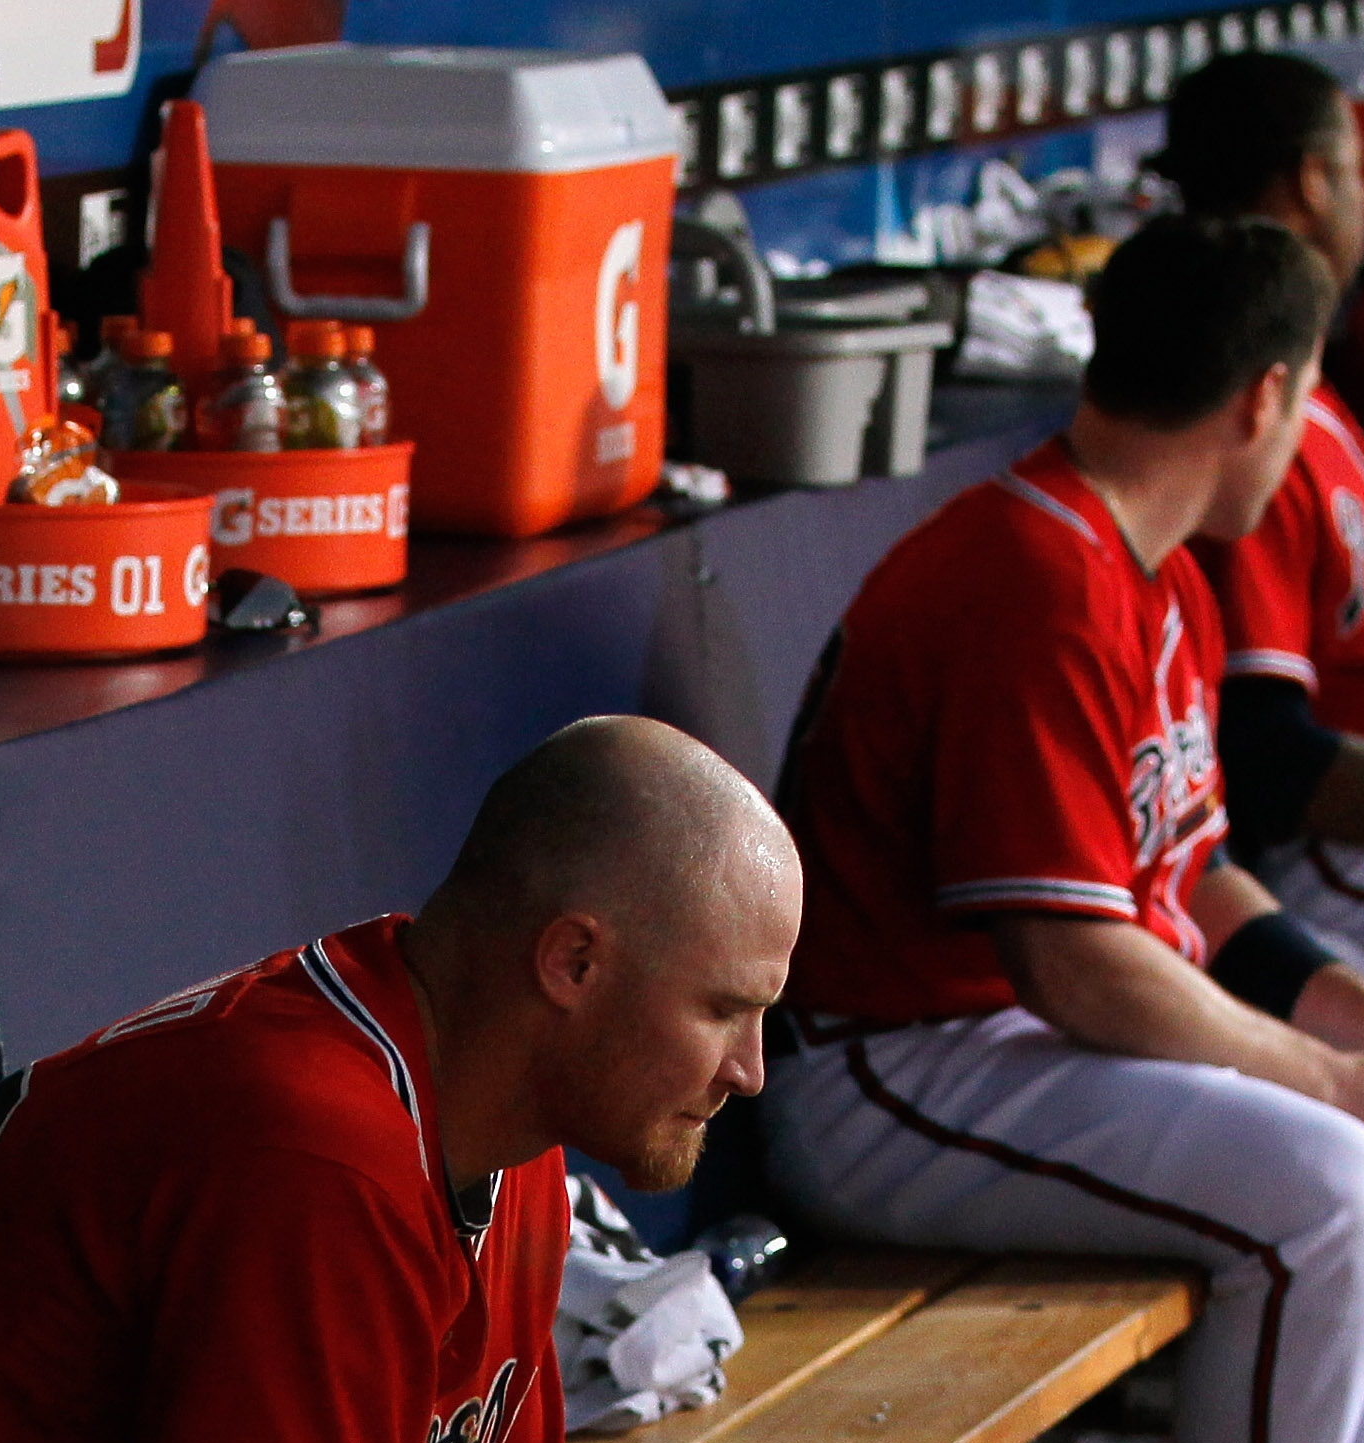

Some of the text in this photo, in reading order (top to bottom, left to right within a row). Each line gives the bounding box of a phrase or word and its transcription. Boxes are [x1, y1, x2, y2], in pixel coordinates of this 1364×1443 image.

[593, 218, 645, 412] G
[210, 487, 255, 546] G
[257, 494, 385, 537] SERIES
[110, 555, 166, 617] 01
